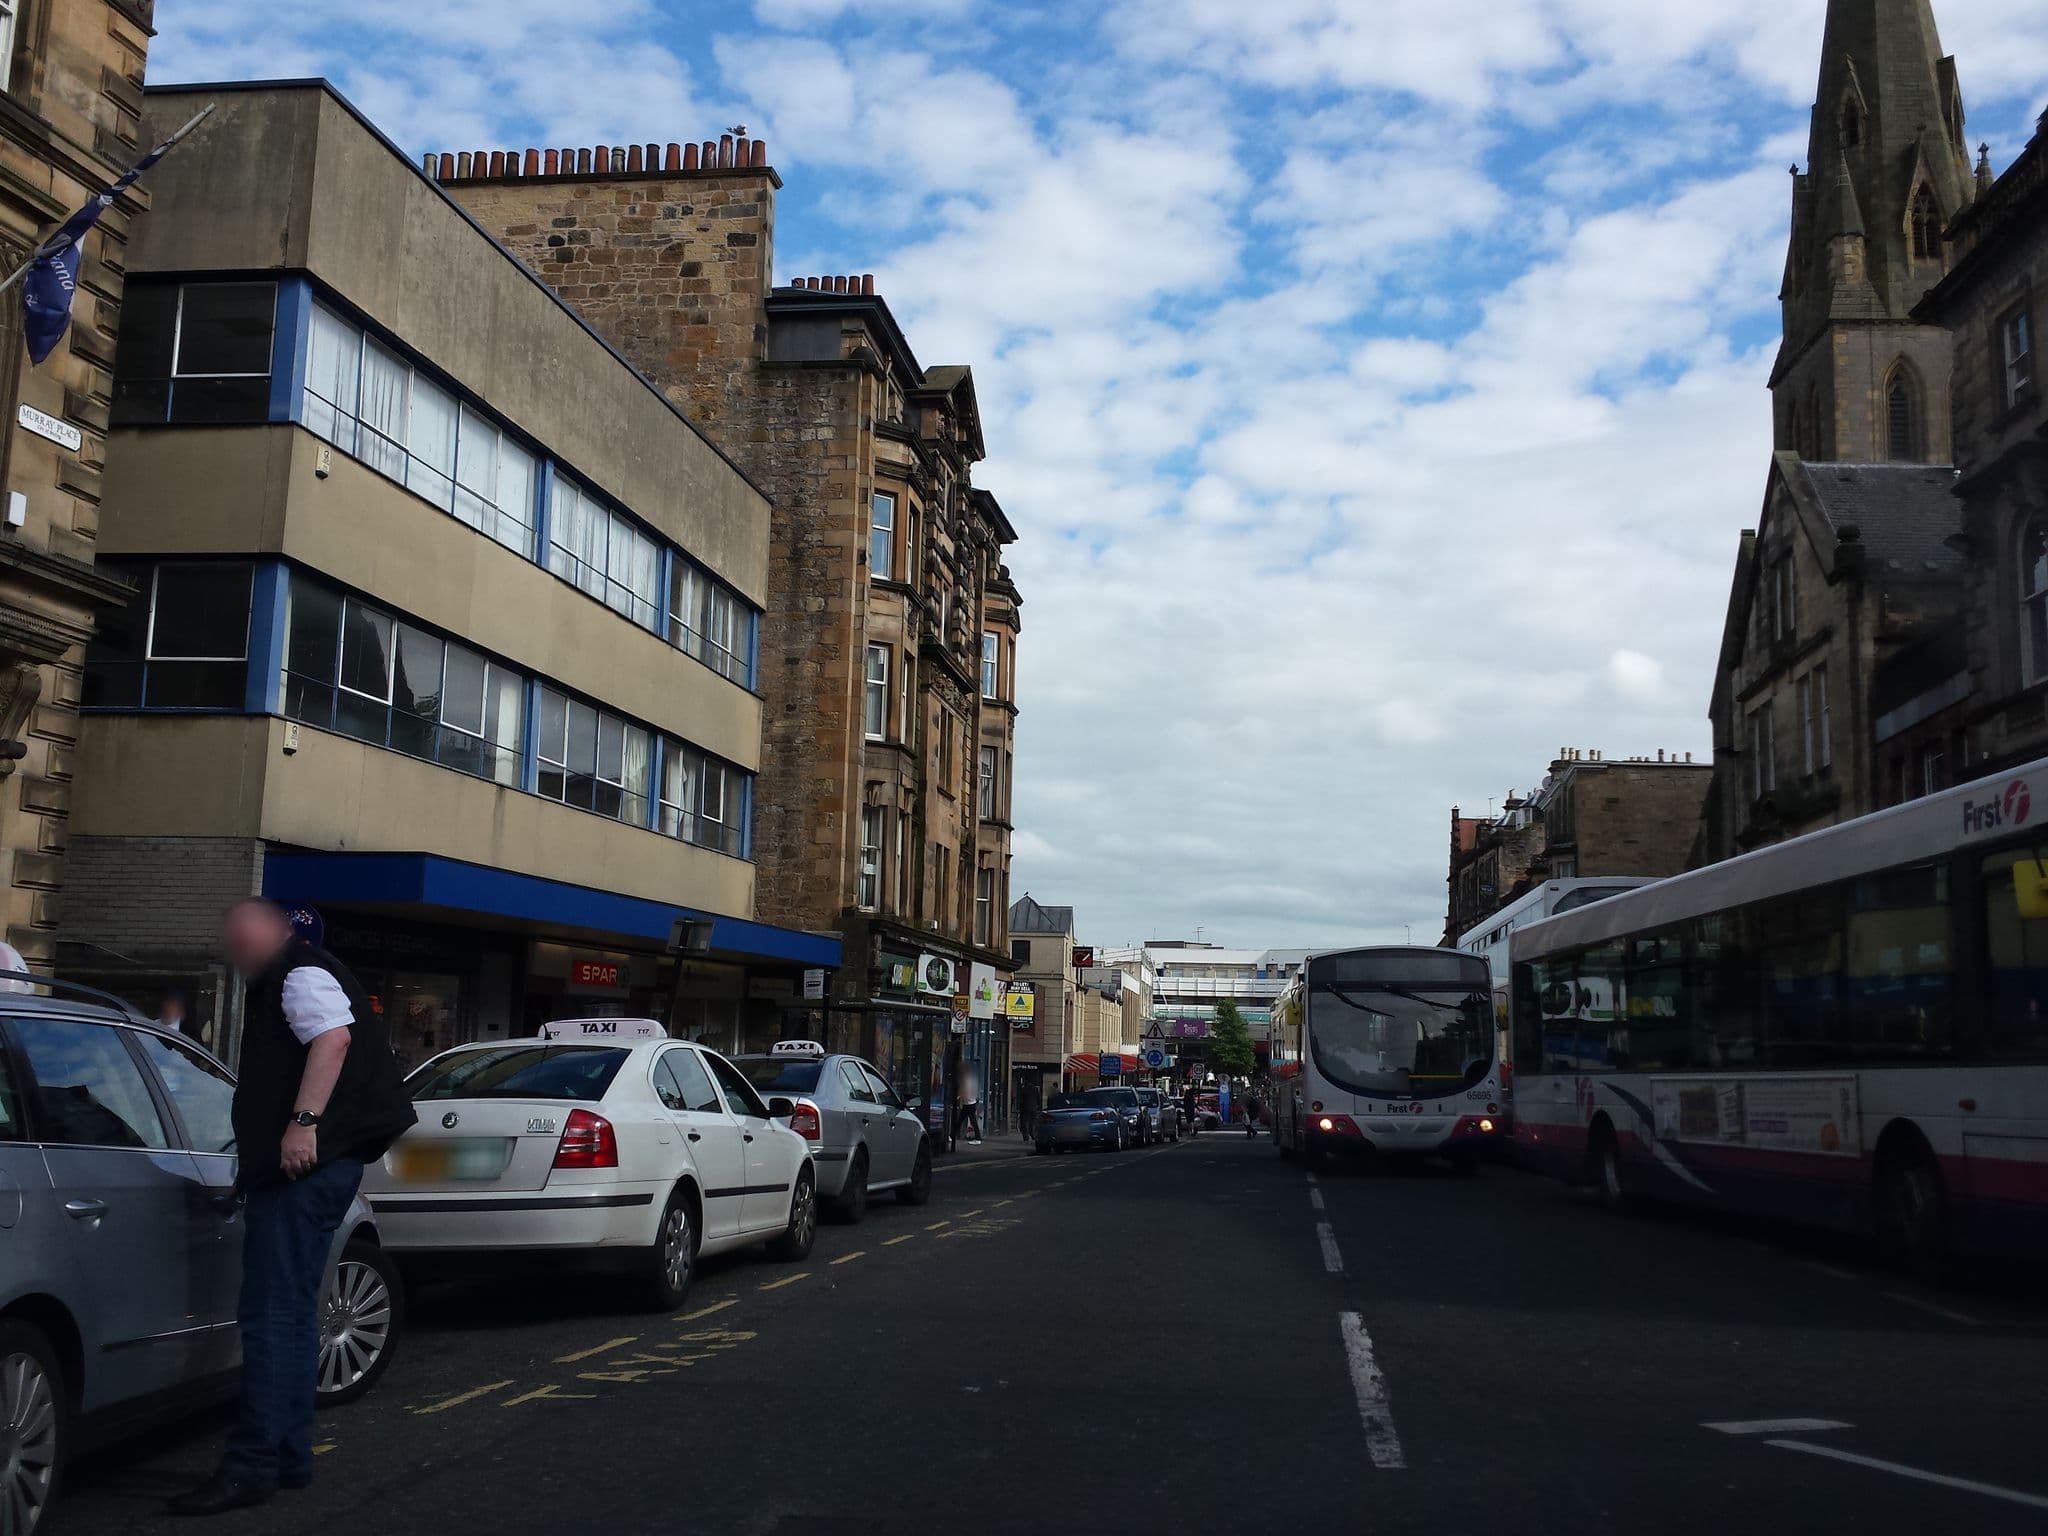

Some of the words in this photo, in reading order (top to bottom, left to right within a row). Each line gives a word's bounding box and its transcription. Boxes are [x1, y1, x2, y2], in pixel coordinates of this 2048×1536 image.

[22, 407, 55, 431] MURRAY
[56, 424, 79, 441] PLACE
[1963, 793, 2003, 835] First
[581, 964, 618, 984] SPAR
[580, 1022, 617, 1034] TAXI
[775, 1042, 816, 1052] TAXI
[1386, 1102, 1408, 1114] First
